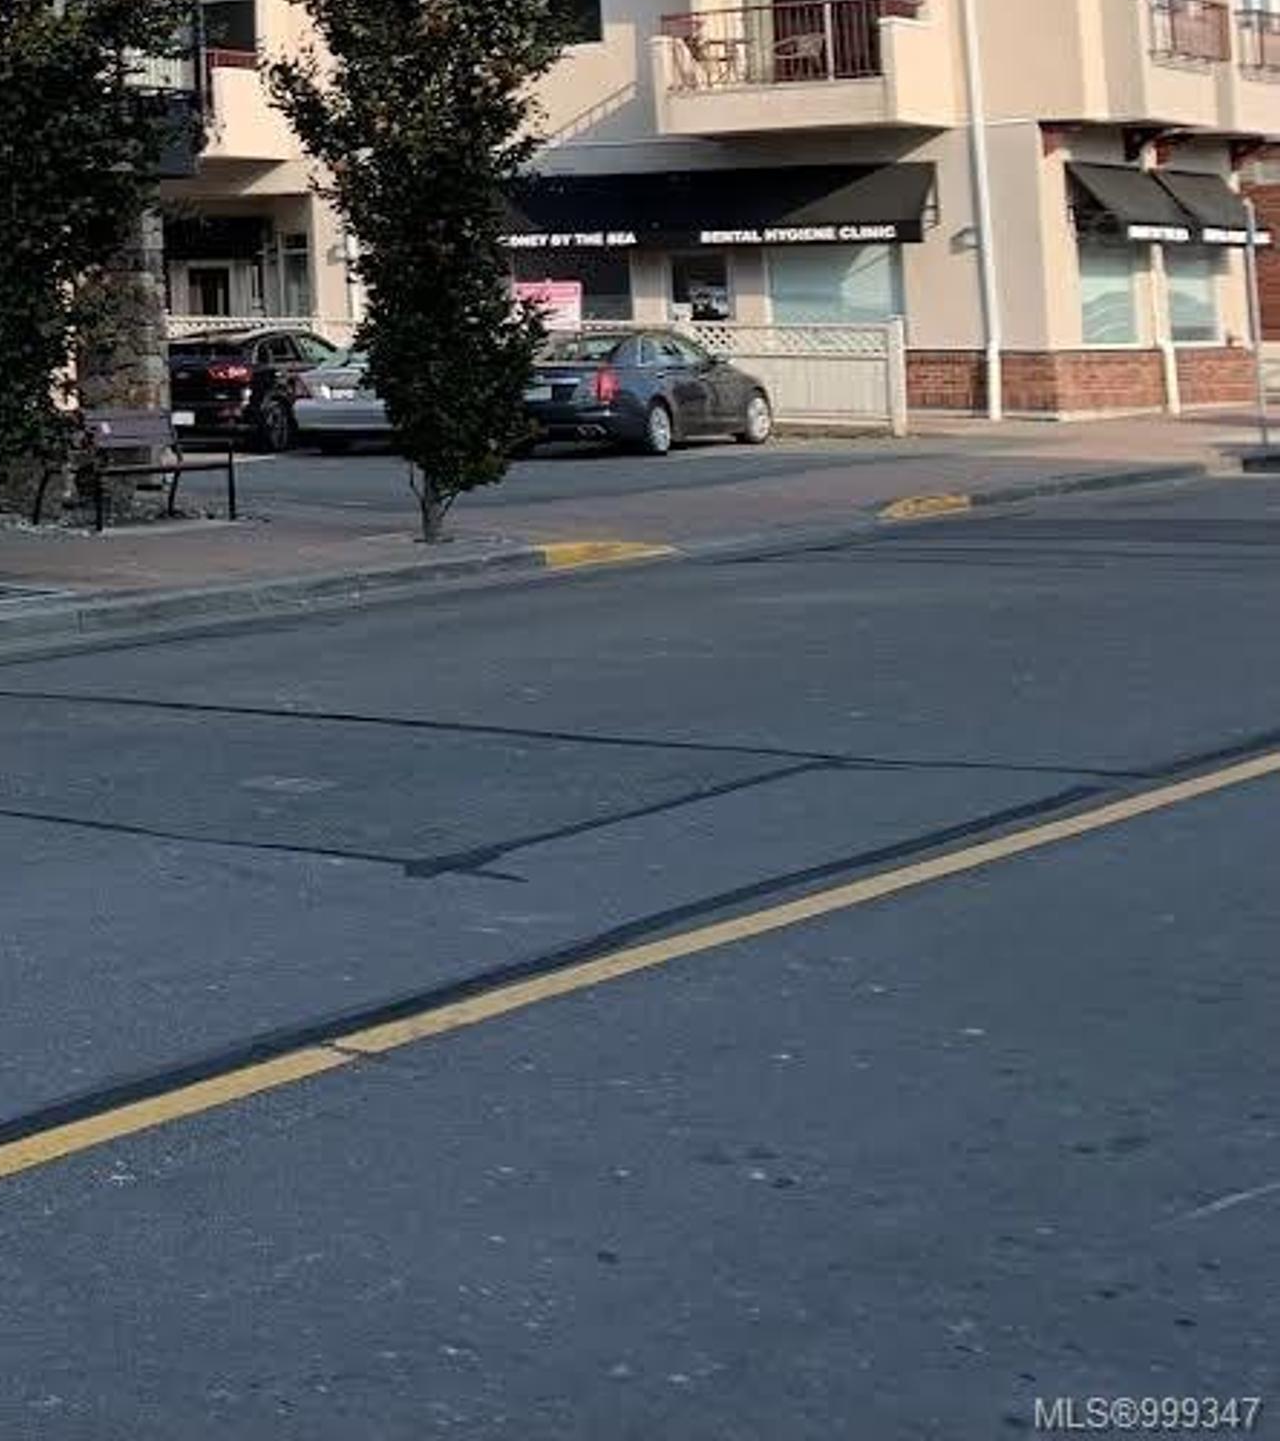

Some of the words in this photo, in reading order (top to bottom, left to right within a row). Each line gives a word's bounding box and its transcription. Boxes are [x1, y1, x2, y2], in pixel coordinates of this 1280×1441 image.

[550, 234, 572, 247] BY
[574, 233, 604, 246] THE
[606, 231, 637, 245] SEA
[700, 230, 762, 243] DENTAL
[763, 227, 836, 241] HYGIENE
[839, 225, 896, 240] CLINIC
